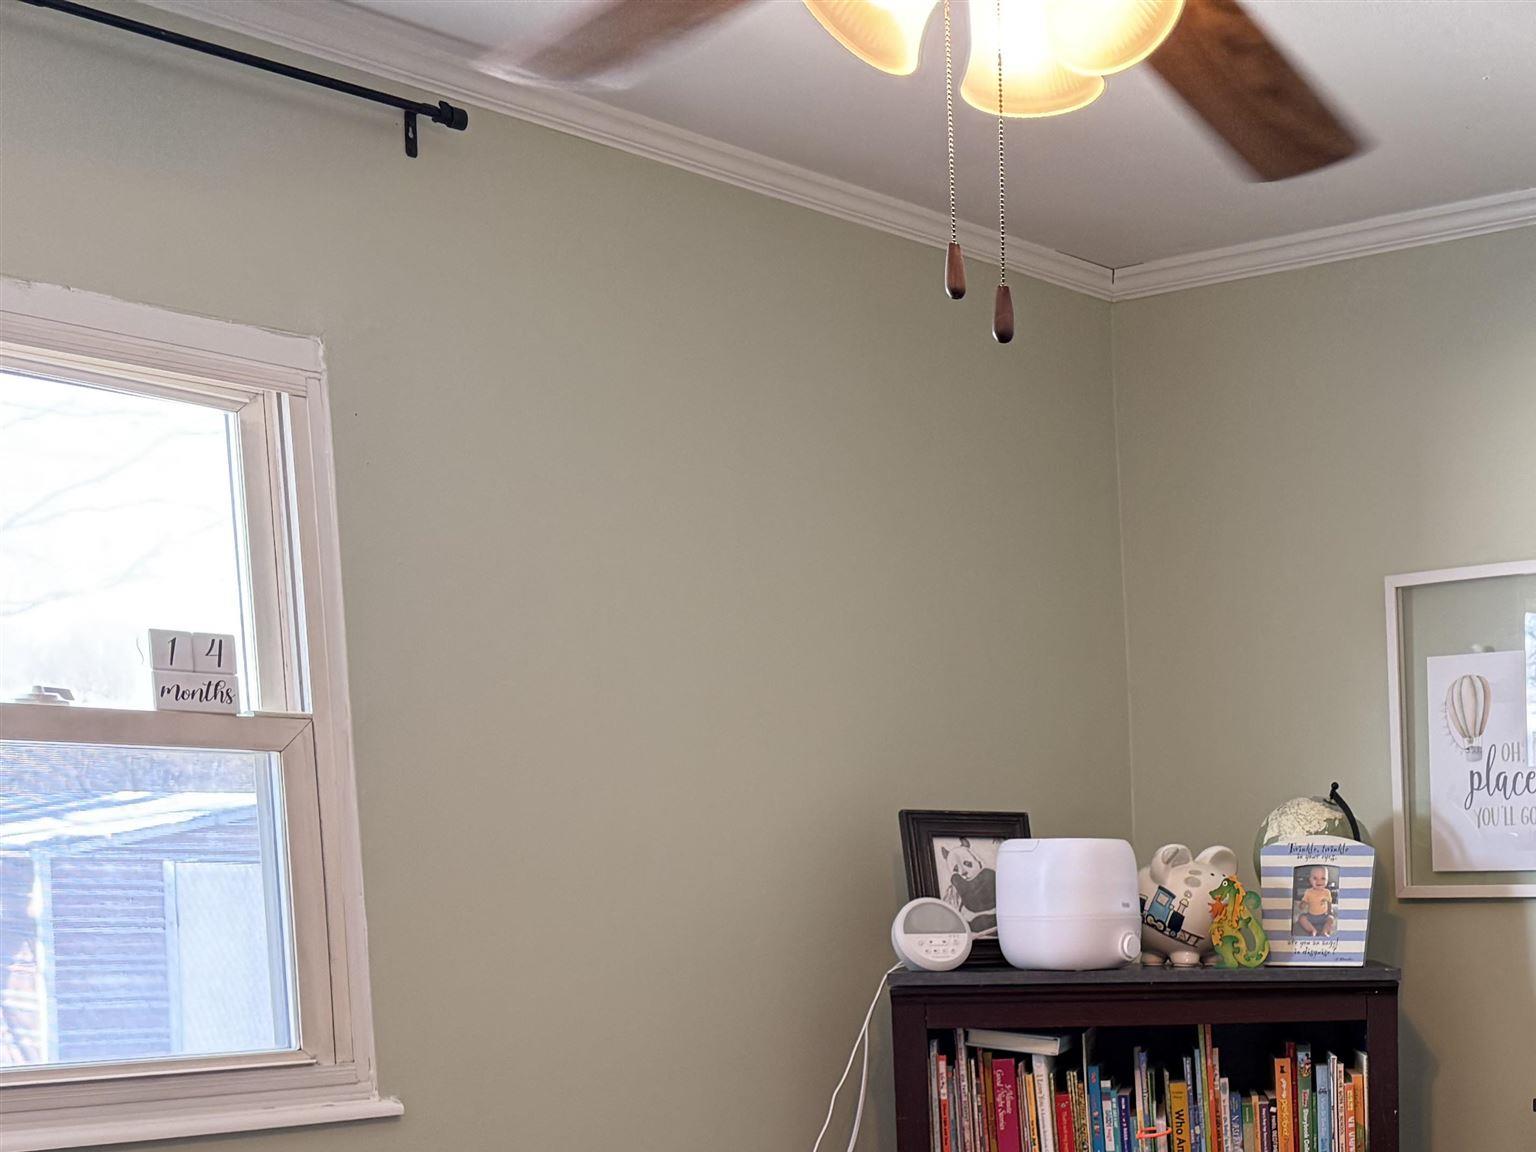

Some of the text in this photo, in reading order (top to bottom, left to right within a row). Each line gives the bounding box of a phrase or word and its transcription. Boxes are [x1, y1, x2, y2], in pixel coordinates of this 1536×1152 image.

[160, 680, 236, 705] months
[1473, 805, 1515, 829] YOU'LL
[1322, 842, 1350, 855] twinkle
[1174, 1109, 1187, 1135] Who
[1302, 1108, 1310, 1138] Storybook
